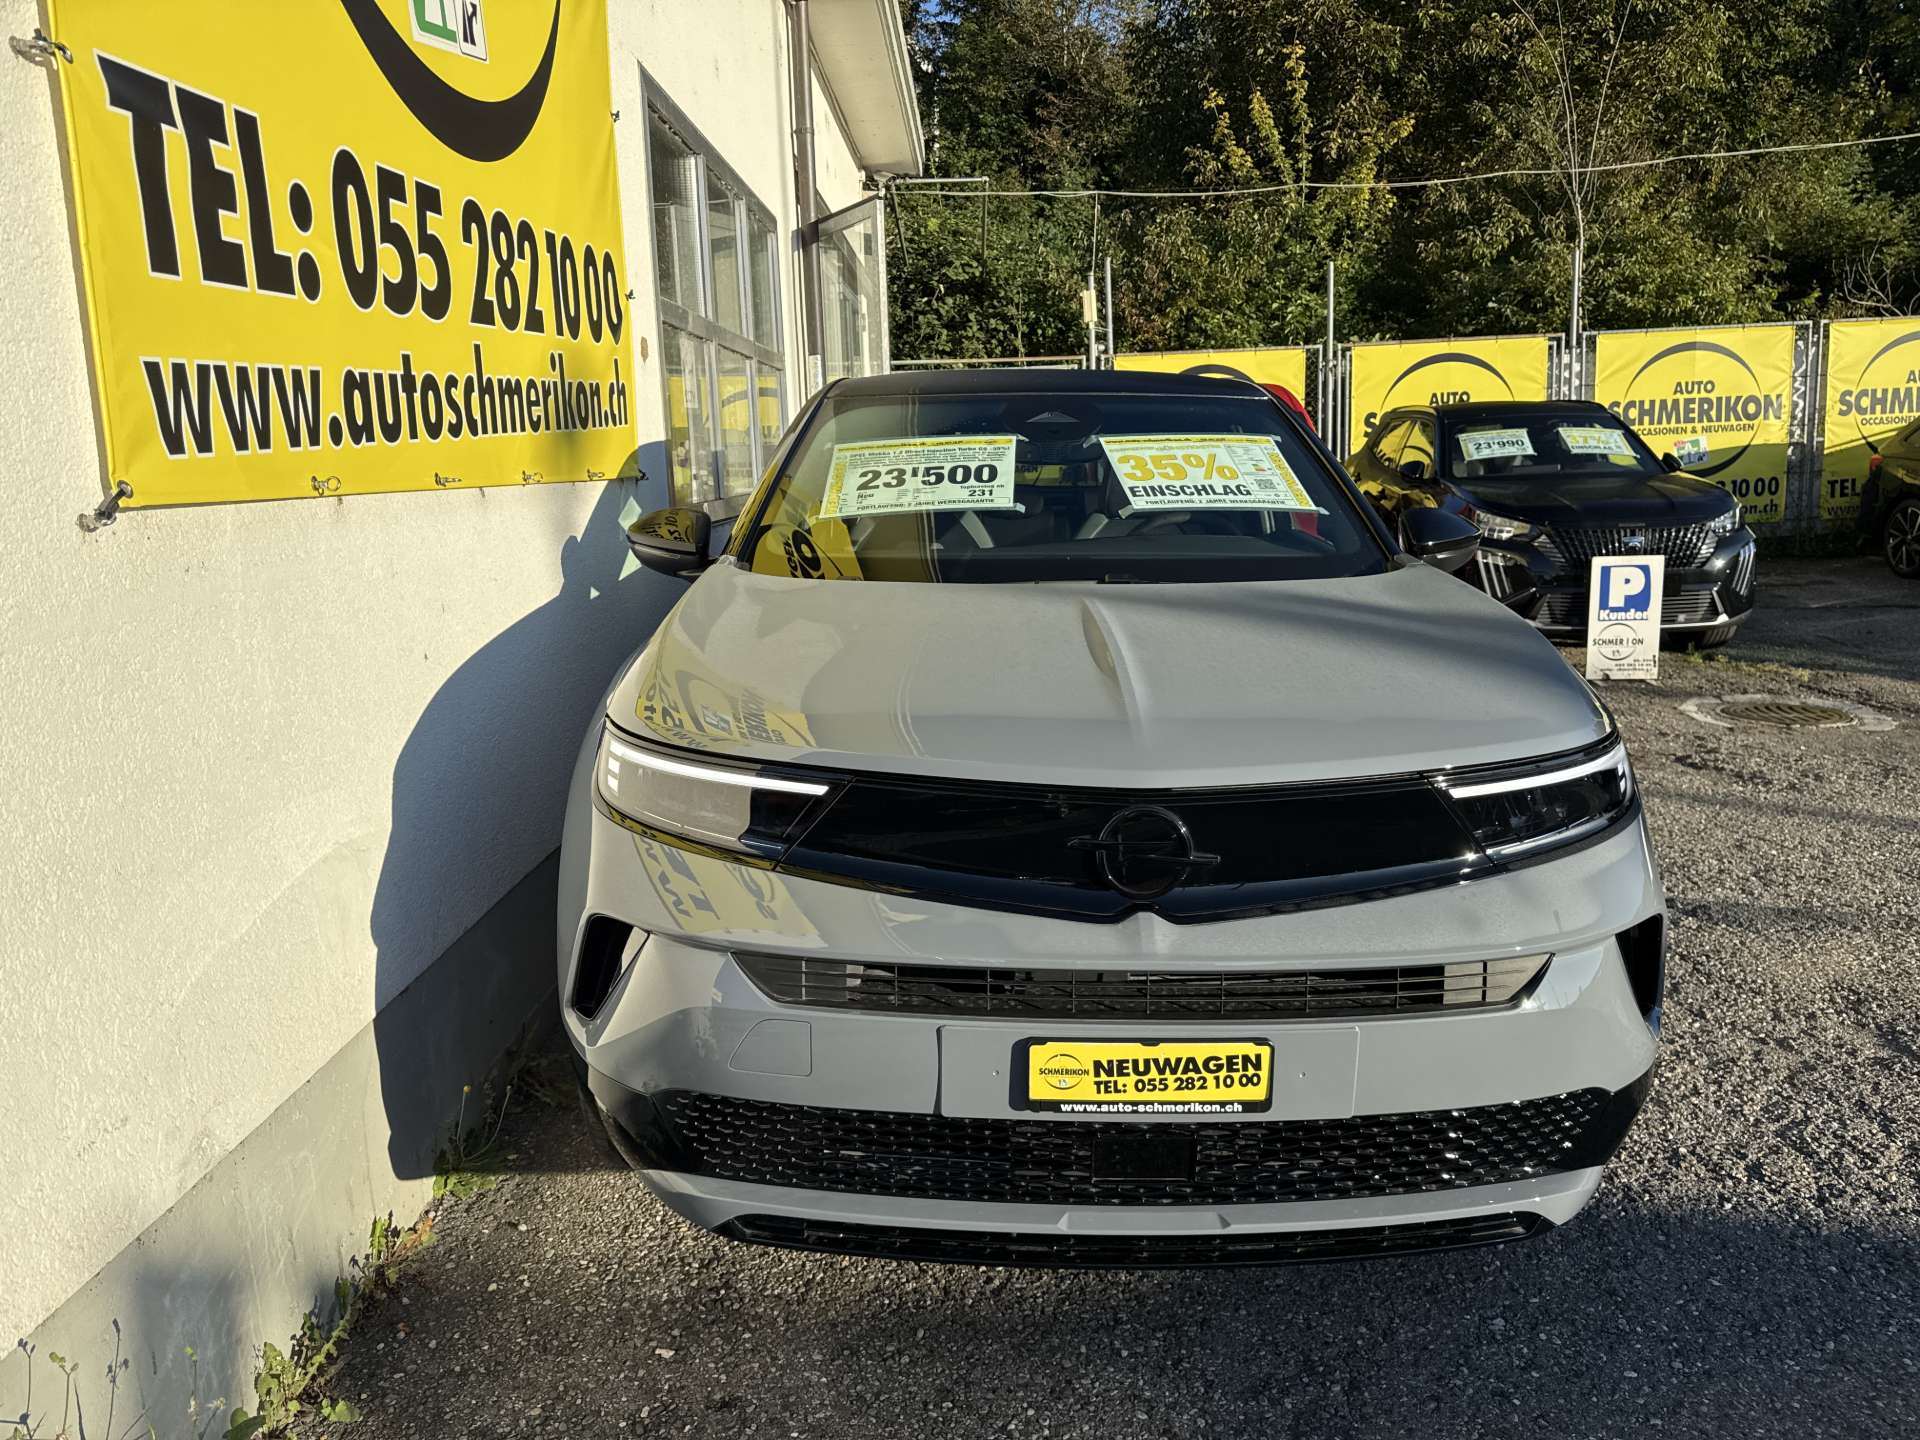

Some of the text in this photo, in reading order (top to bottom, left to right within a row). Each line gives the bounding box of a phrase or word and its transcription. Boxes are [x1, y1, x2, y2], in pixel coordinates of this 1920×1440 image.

[94, 50, 321, 301] TEL:
[331, 147, 452, 321] 055
[461, 197, 545, 334] 282
[1673, 380, 1716, 395] AUTO
[140, 343, 629, 458] www.autoschmerikon.ch
[1429, 391, 1471, 406] AUTO
[1608, 394, 1783, 427] SCHMERIKON
[1632, 424, 1755, 437] CCASIONEN & NEUWAGEN
[1473, 439, 1525, 450] 23'990
[1117, 453, 1239, 482] 35%
[856, 464, 998, 491] 23'500
[968, 489, 994, 497] 231
[1127, 484, 1253, 498] EINSCHLAG
[1608, 567, 1646, 608] P
[1039, 1067, 1090, 1077] SCHMERIKON
[1093, 1053, 1262, 1078] NEUWAGEN
[1093, 1073, 1262, 1095] TEL: 055 282 10 00
[1060, 1102, 1243, 1113] www.auto-schmerikon.ch
